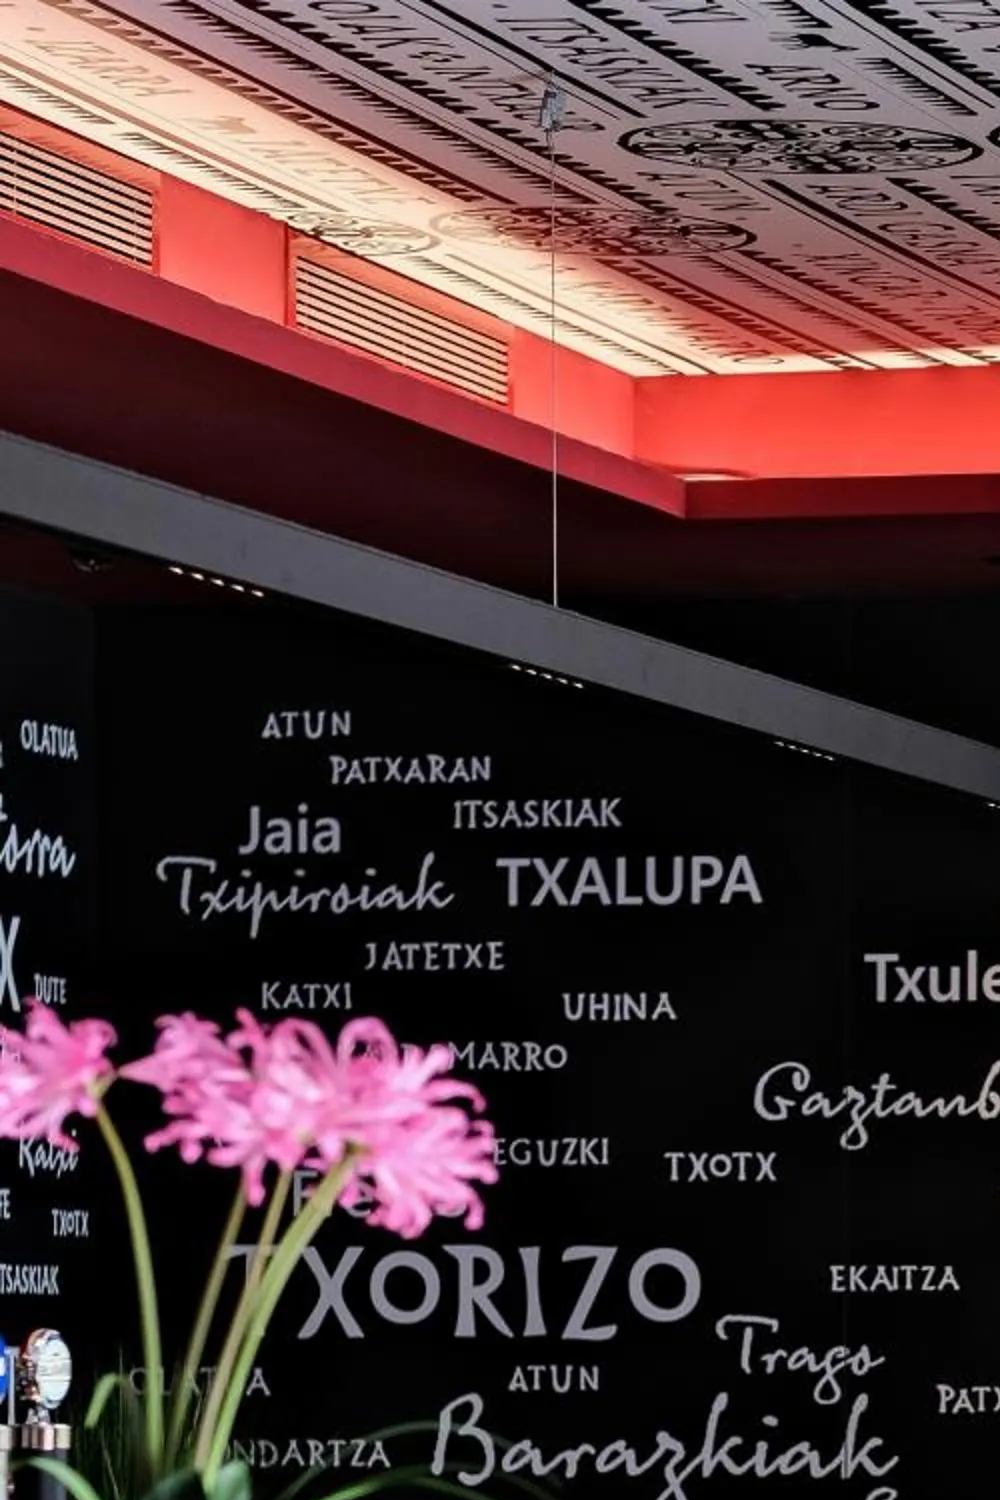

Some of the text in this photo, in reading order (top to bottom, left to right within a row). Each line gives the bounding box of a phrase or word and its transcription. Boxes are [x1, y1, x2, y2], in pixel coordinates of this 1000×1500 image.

[496, 17, 731, 108] ITSASKIAK
[745, 63, 880, 112] ARNO
[636, 171, 771, 214] ATUN
[262, 711, 351, 739] ATUN
[21, 719, 79, 761] OLATUA
[330, 755, 491, 784] PATXARAN
[453, 799, 622, 828] ITSASKIAK
[239, 803, 341, 854] Jaia
[156, 851, 455, 938] Txipiroiak
[496, 855, 763, 906] TXALUPA
[365, 941, 505, 970] JATETXE
[33, 973, 67, 1004] DUTE
[261, 981, 352, 1009] KATXI
[562, 992, 678, 1021] UHINA
[494, 1138, 609, 1165] EGUZKI
[664, 1152, 777, 1181] TXOTX
[52, 1208, 89, 1236] TXOTX
[829, 1265, 960, 1292] EKAITZA
[715, 1315, 885, 1404] Trago
[129, 1367, 271, 1397] OLATA
[508, 1365, 600, 1392] ATUN
[223, 1439, 391, 1469] NDARTZA
